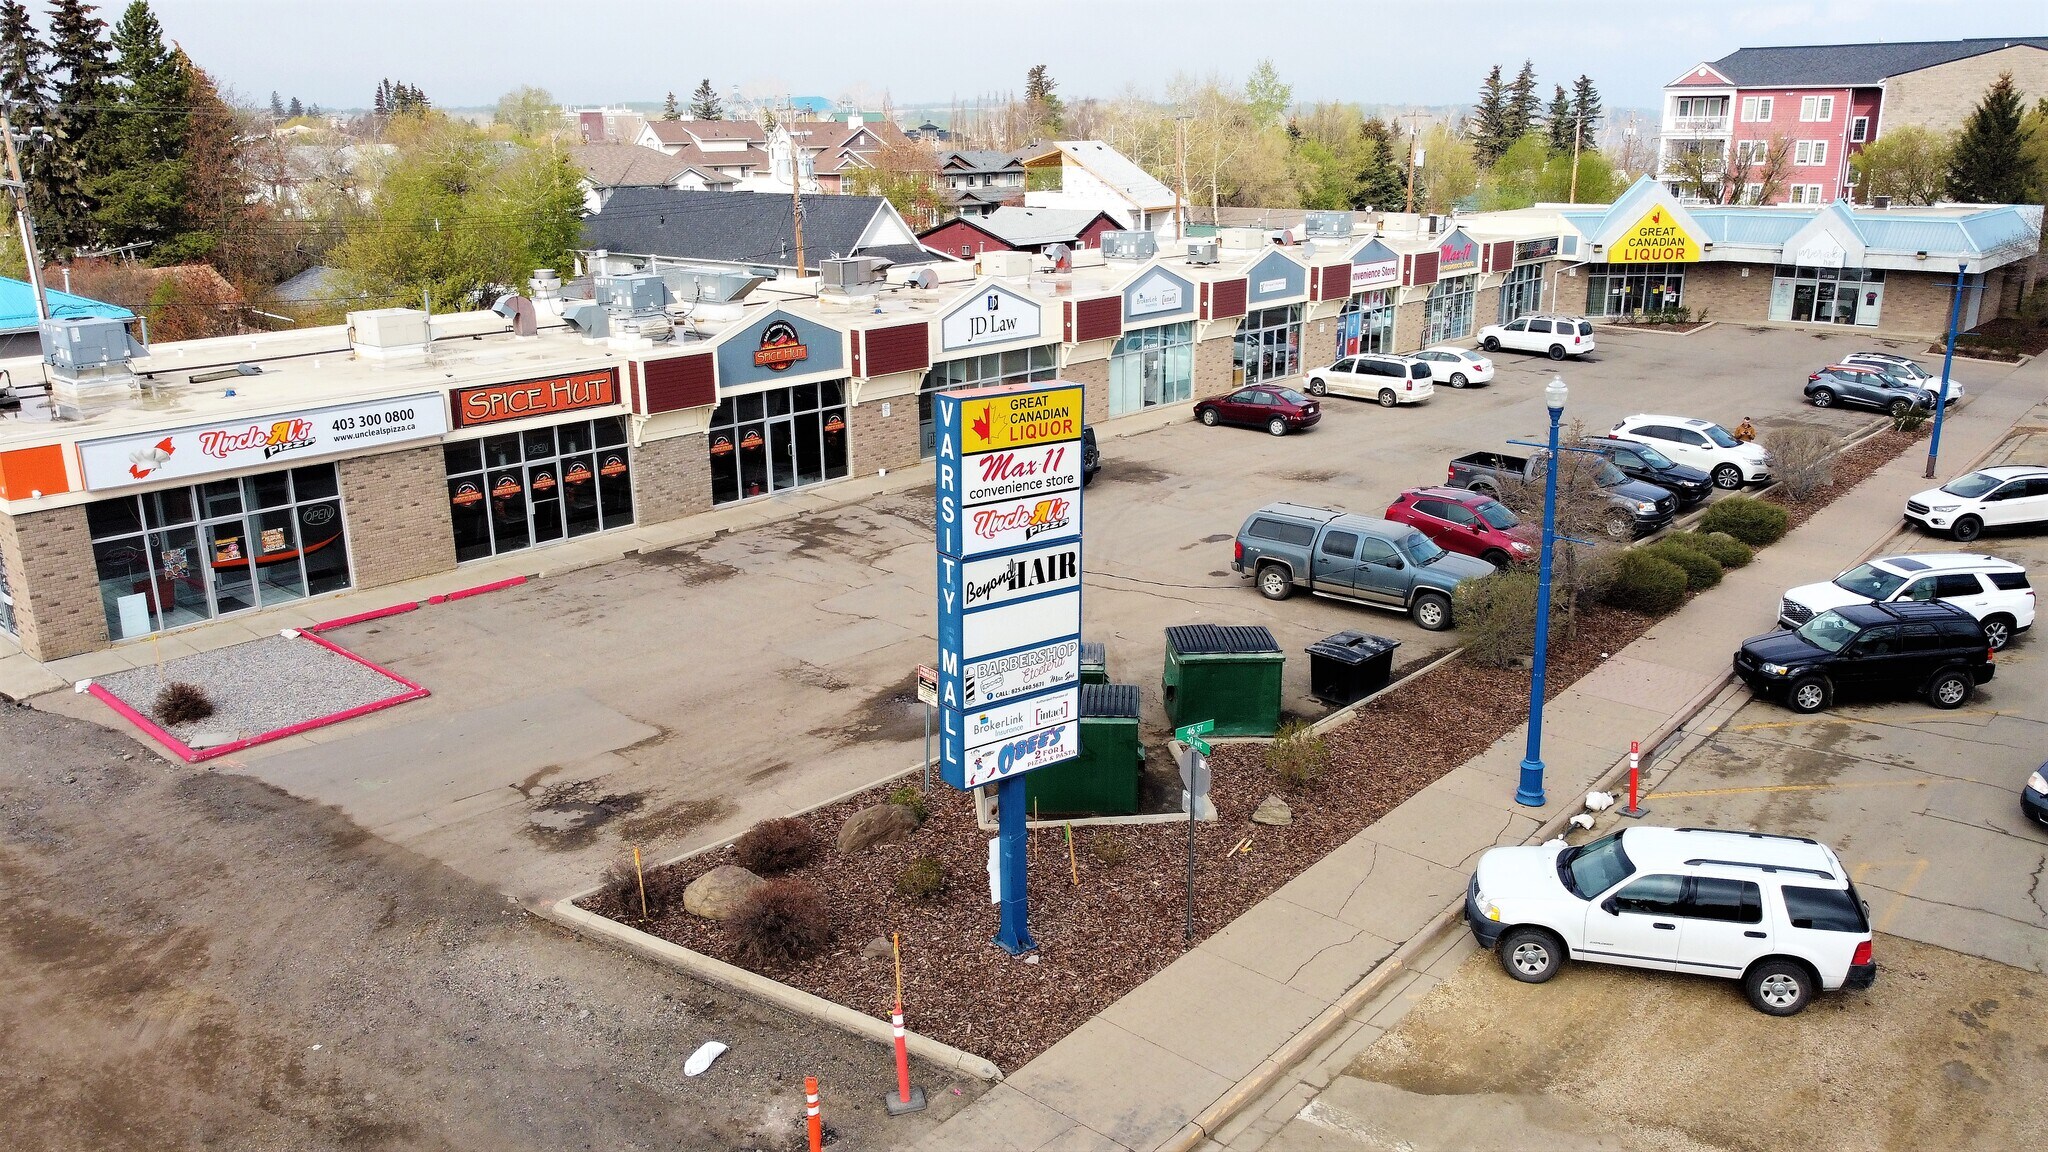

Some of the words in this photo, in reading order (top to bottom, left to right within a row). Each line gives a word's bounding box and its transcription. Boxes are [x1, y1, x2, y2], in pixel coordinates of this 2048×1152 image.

[1640, 227, 1676, 236] GREAT
[1628, 237, 1685, 247] CANADIAN
[1624, 248, 1685, 261] LIQUOR
[968, 317, 987, 341] JD
[990, 315, 1017, 333] Law
[758, 351, 782, 362] SPICE
[784, 348, 804, 358] HUT
[466, 388, 547, 419] SPICE
[550, 379, 607, 407] HUT
[1010, 395, 1048, 410] GREAT
[332, 418, 355, 431] 403
[358, 413, 382, 427] 300
[385, 408, 415, 423] 0800
[1010, 406, 1069, 424] CANADIAN
[199, 425, 268, 458] Uncle
[266, 418, 313, 446] Al's
[333, 423, 416, 442] www.unclealspizza.ca
[1010, 419, 1073, 441] LIQUOR
[269, 437, 317, 457] PIZZA
[969, 480, 1042, 499] convenience
[1046, 474, 1074, 488] store
[305, 508, 332, 521] OPEN
[940, 400, 956, 614] VARSITY
[974, 504, 1031, 539] Uncle
[1029, 498, 1070, 525] Al's
[1029, 518, 1070, 537] PIZZA
[966, 558, 1016, 604] Beyond
[1007, 551, 1077, 591] HAIR
[977, 641, 1077, 679] BARBERSHOP
[942, 647, 958, 765] MALL
[973, 712, 1024, 735] BrokerLink
[995, 724, 1024, 737] Insurance
[1186, 727, 1195, 735] 46
[1197, 724, 1204, 733] ST
[1027, 758, 1047, 768] PIZZA
[1056, 749, 1076, 760] PASTA
[1035, 750, 1041, 760] 2
[1043, 746, 1059, 757] FOR
[1060, 743, 1064, 752] 1
